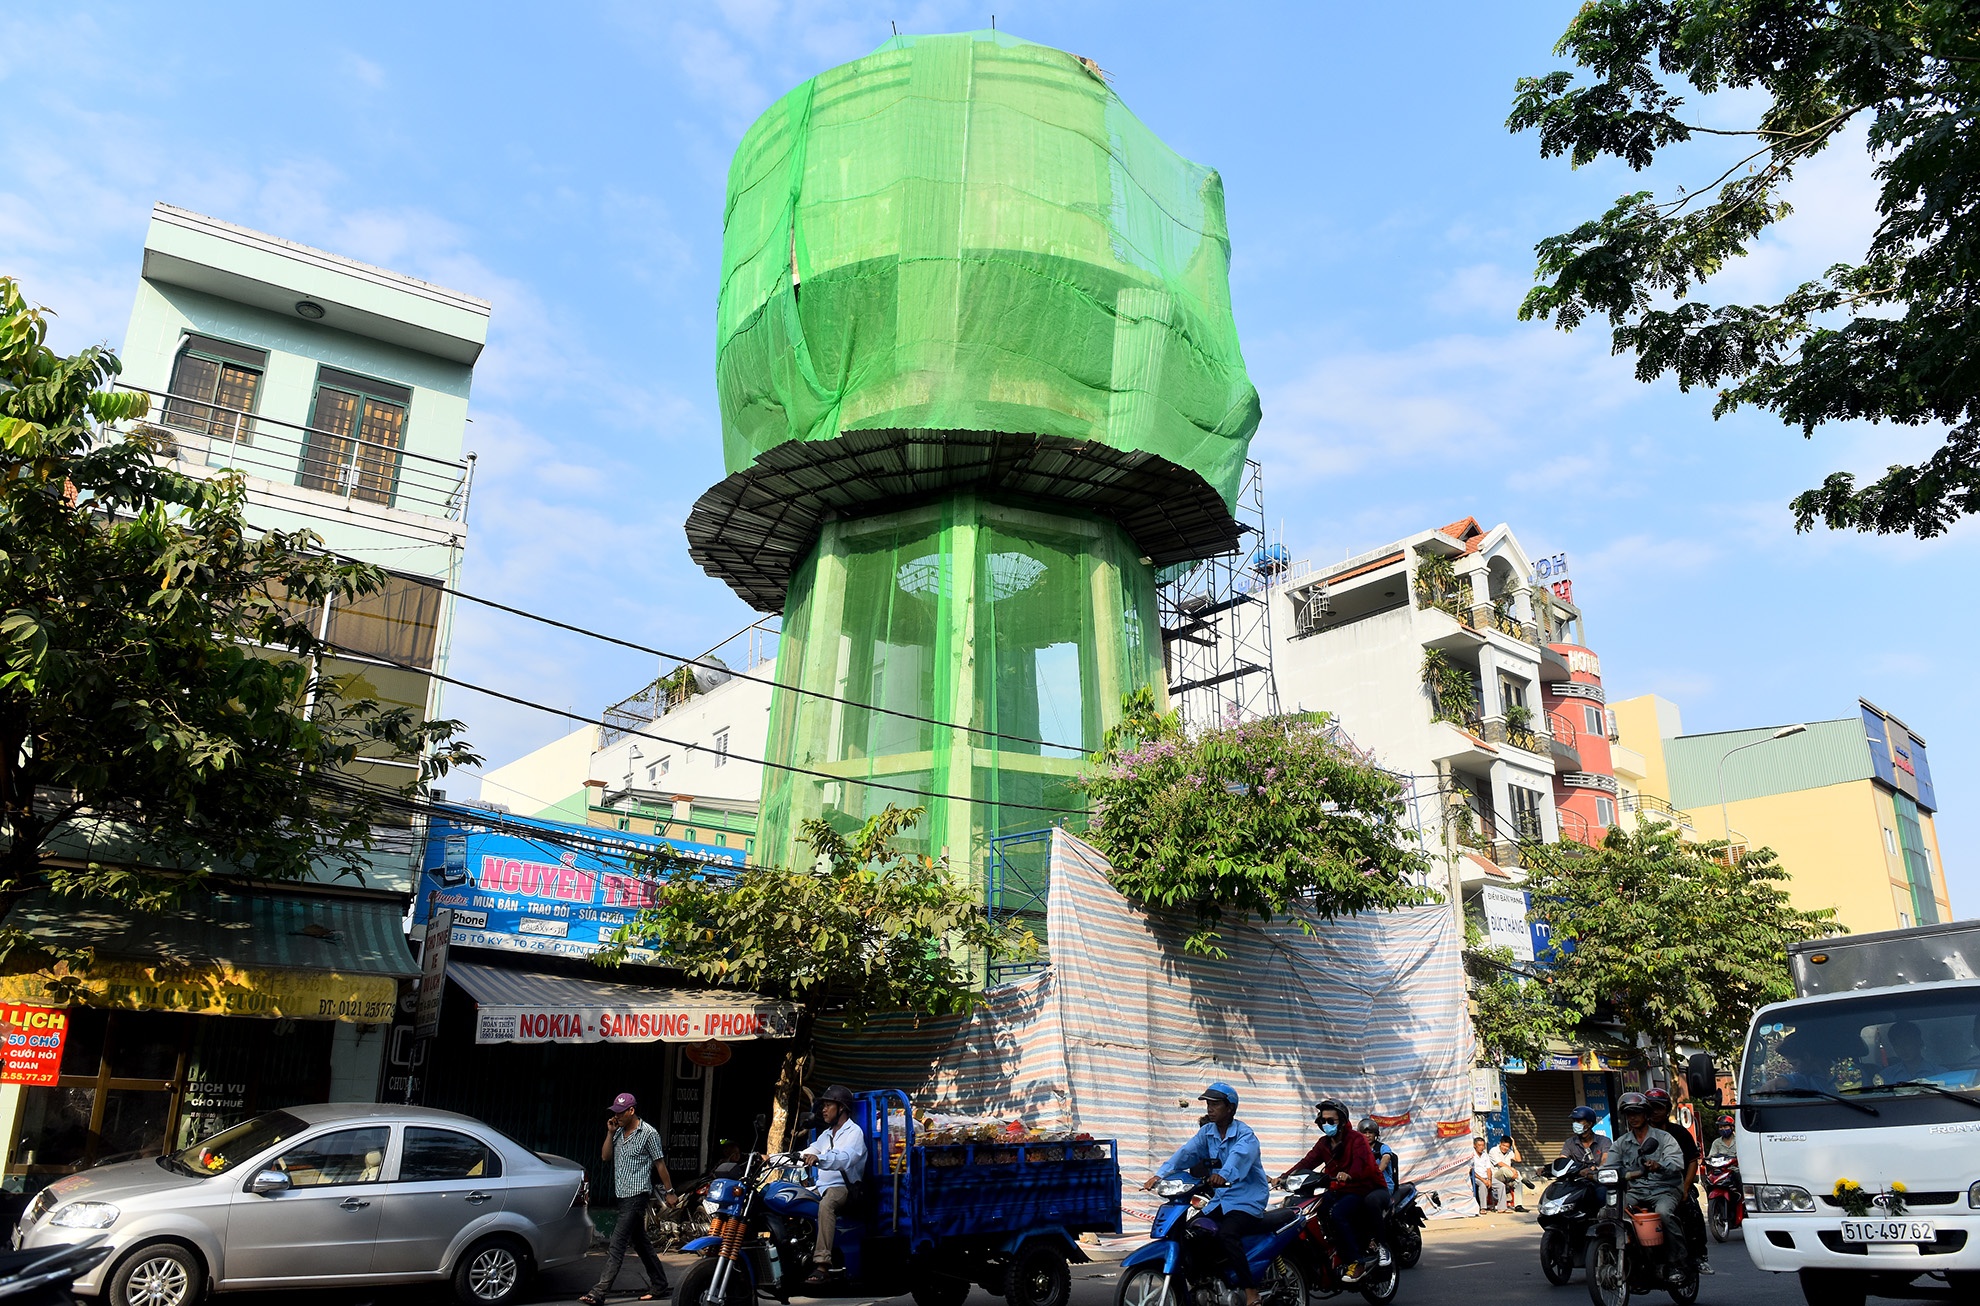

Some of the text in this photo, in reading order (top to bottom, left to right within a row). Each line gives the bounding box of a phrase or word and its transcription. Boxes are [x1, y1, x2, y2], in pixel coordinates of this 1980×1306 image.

[478, 851, 598, 905] NGUYỄN
[473, 896, 494, 909] MUA
[498, 896, 519, 911] BÁN
[527, 902, 551, 916] TRAO
[338, 1000, 363, 1017] 0121
[10, 1010, 66, 1031] LỊCH
[519, 1013, 769, 1038] NOKIA SAMSUNG IPHONE
[8, 1032, 61, 1048] 50 CHỖ
[10, 1049, 36, 1059] CƯỚI
[9, 1061, 39, 1069] QUAN
[191, 1098, 214, 1107] CHO
[1844, 1222, 1933, 1240] 51C-497.62
